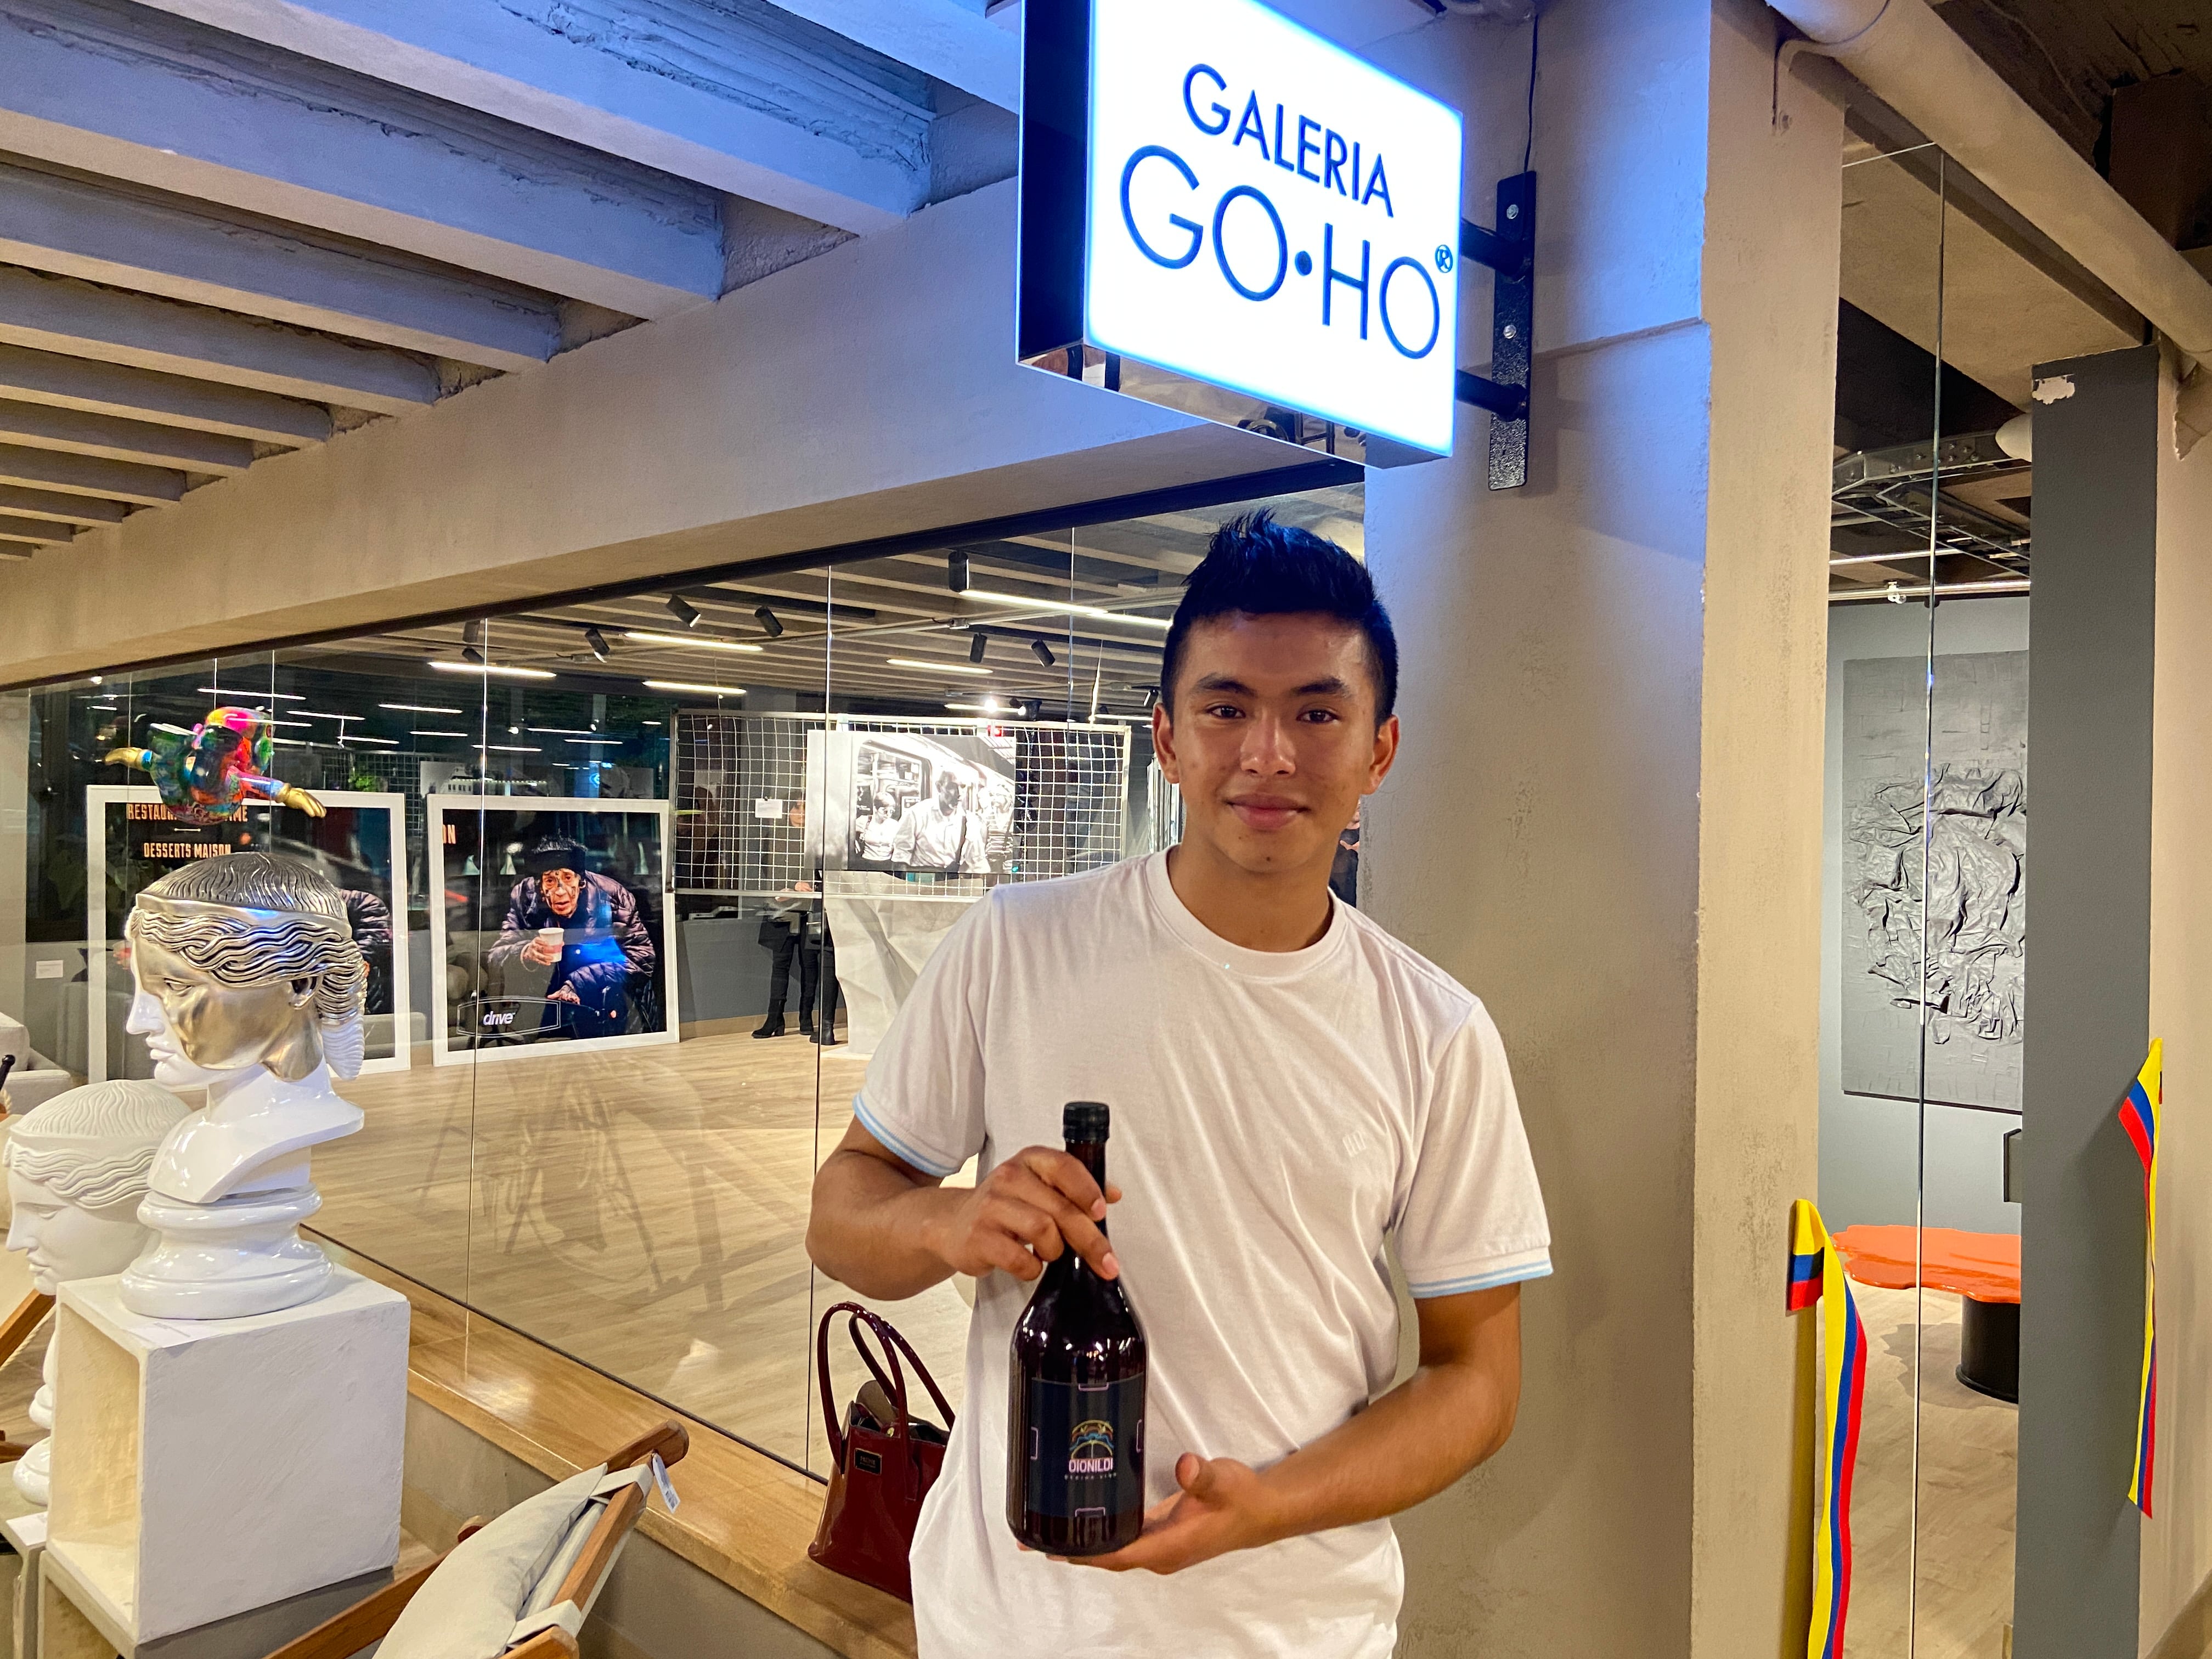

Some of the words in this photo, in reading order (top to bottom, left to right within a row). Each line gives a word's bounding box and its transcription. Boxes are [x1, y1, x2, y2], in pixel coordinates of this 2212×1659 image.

[1183, 63, 1394, 218] GALERIA
[144, 842, 191, 859] DESSERTS
[194, 843, 232, 859] MAISON
[483, 1011, 514, 1026] drive
